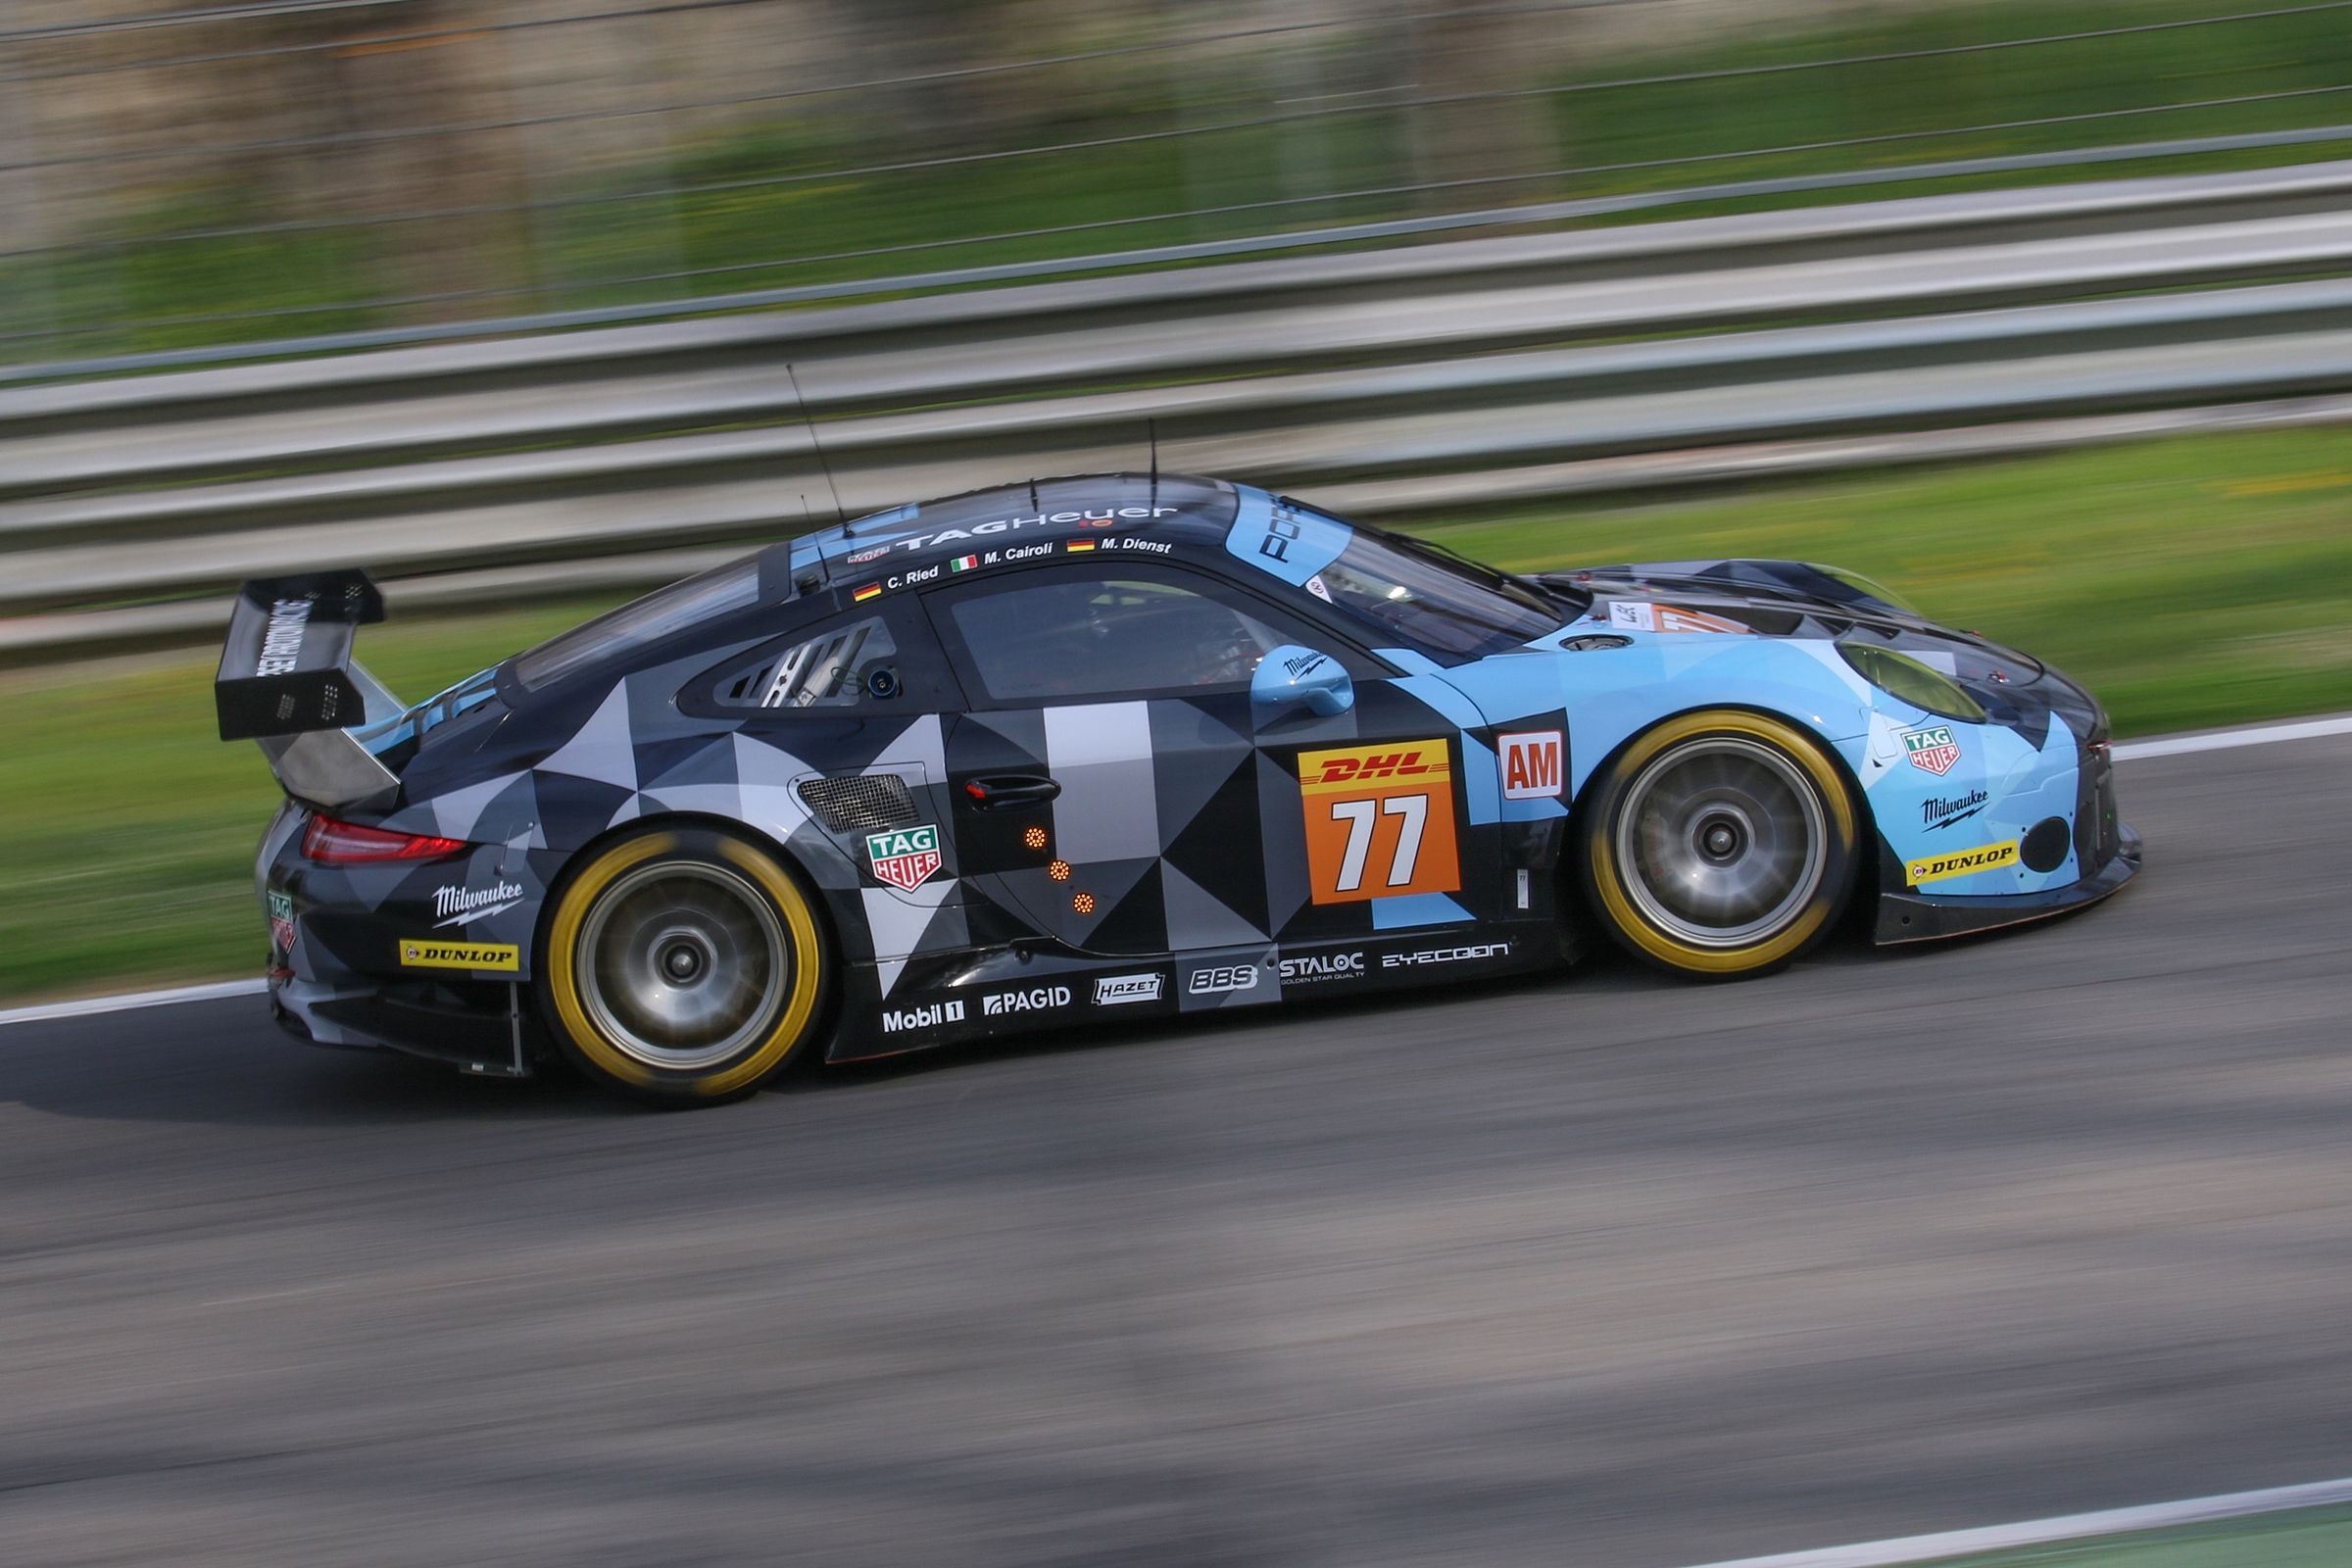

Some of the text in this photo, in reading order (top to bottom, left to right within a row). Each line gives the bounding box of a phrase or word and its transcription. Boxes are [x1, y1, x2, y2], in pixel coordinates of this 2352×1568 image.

[984, 542, 1054, 564] M. Cairoli
[1101, 538, 1173, 555] M. Dienst
[887, 565, 939, 590] C. Ried
[1283, 650, 1322, 675] Milwauk
[1909, 728, 1950, 750] TAG
[1320, 751, 1431, 783] DHL
[1506, 742, 1558, 790] AM
[1912, 745, 1958, 772] HEUER
[1921, 789, 1989, 824] Milwaukee
[873, 829, 932, 857] TAG
[1331, 794, 1429, 892] 77
[876, 854, 937, 886] HEUER
[1931, 847, 2013, 874] DUNLOP
[269, 895, 290, 919] TAG
[431, 880, 523, 918] Milwaukee
[423, 949, 512, 963] DUNLOP
[1279, 952, 1365, 978] STALOC
[1100, 979, 1157, 1000] HAZET
[1189, 964, 1258, 995] BBS
[1281, 971, 1365, 986] GOLDEN STAR QUALTY
[1004, 986, 1071, 1012] PAGID
[883, 1004, 942, 1033] Mobil
